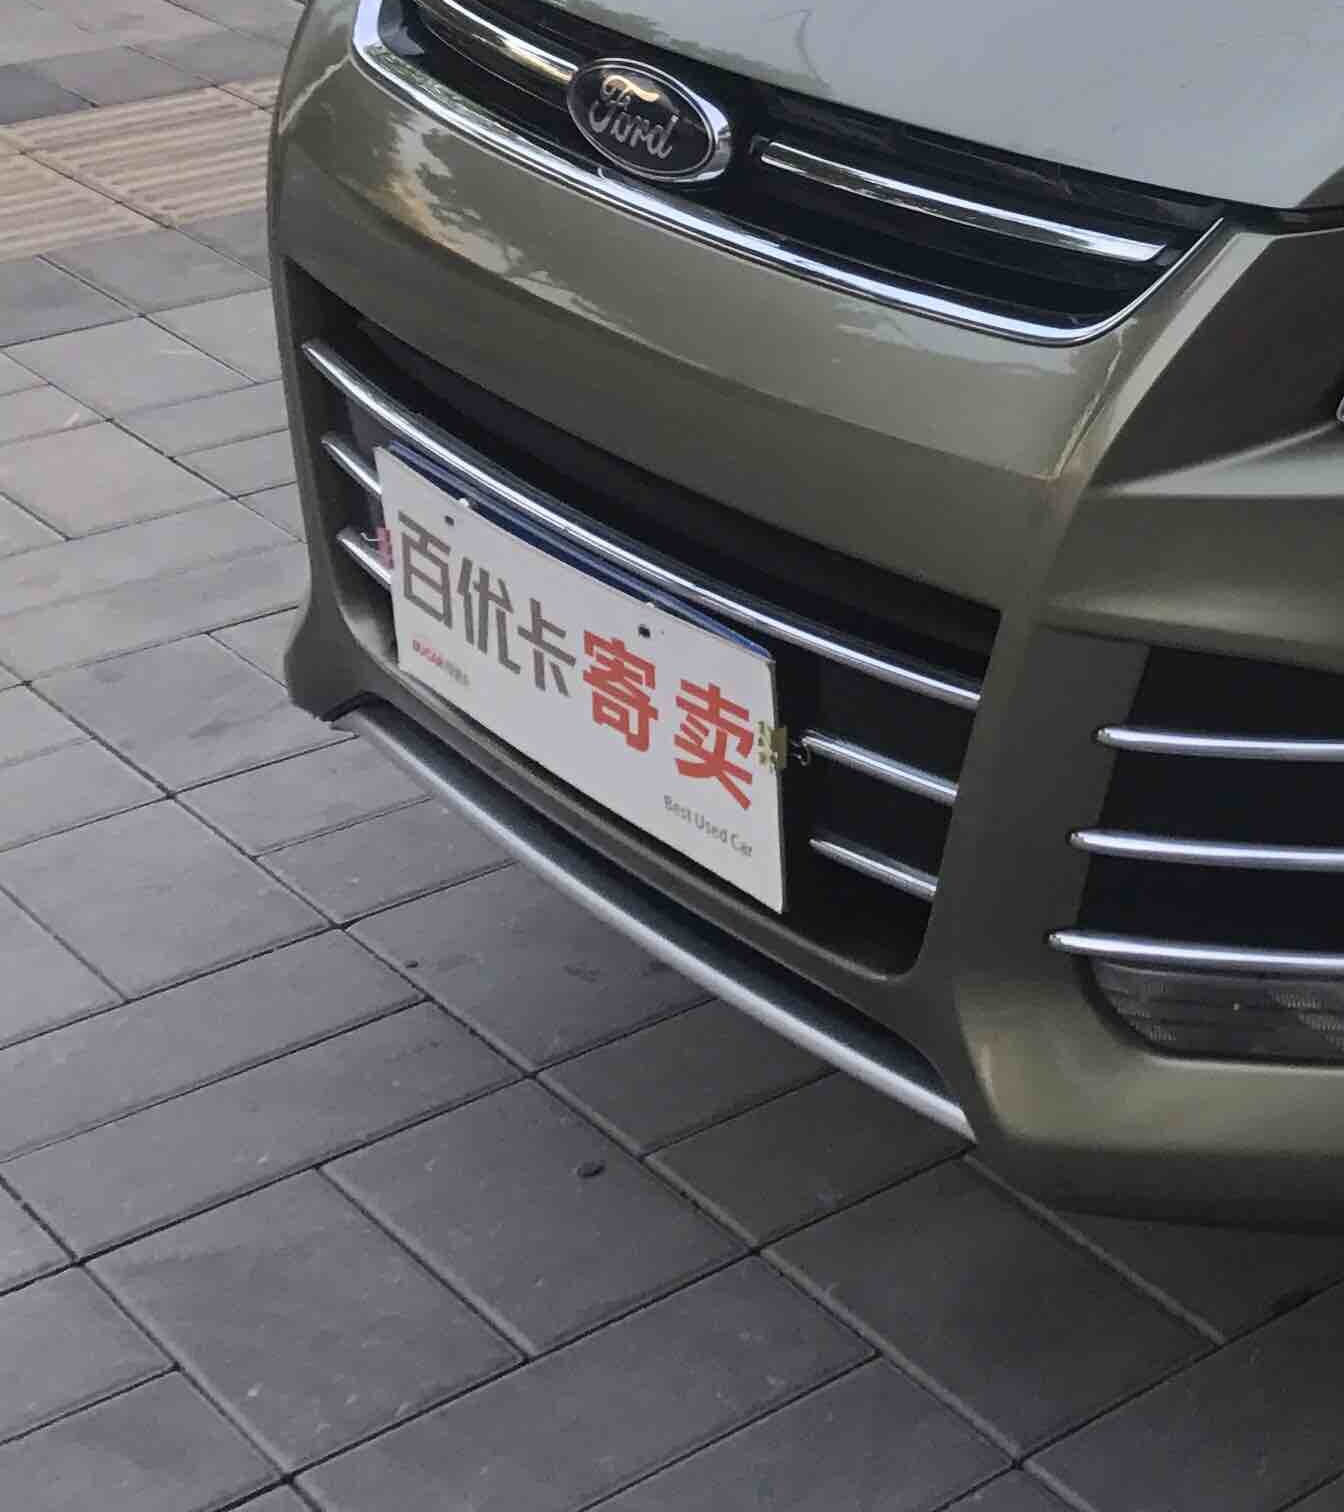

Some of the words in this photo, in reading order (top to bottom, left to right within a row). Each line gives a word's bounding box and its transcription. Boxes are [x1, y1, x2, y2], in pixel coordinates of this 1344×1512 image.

[588, 75, 680, 159] Ford
[663, 794, 692, 825] Best
[694, 810, 729, 844] Used
[730, 832, 753, 857] Car
